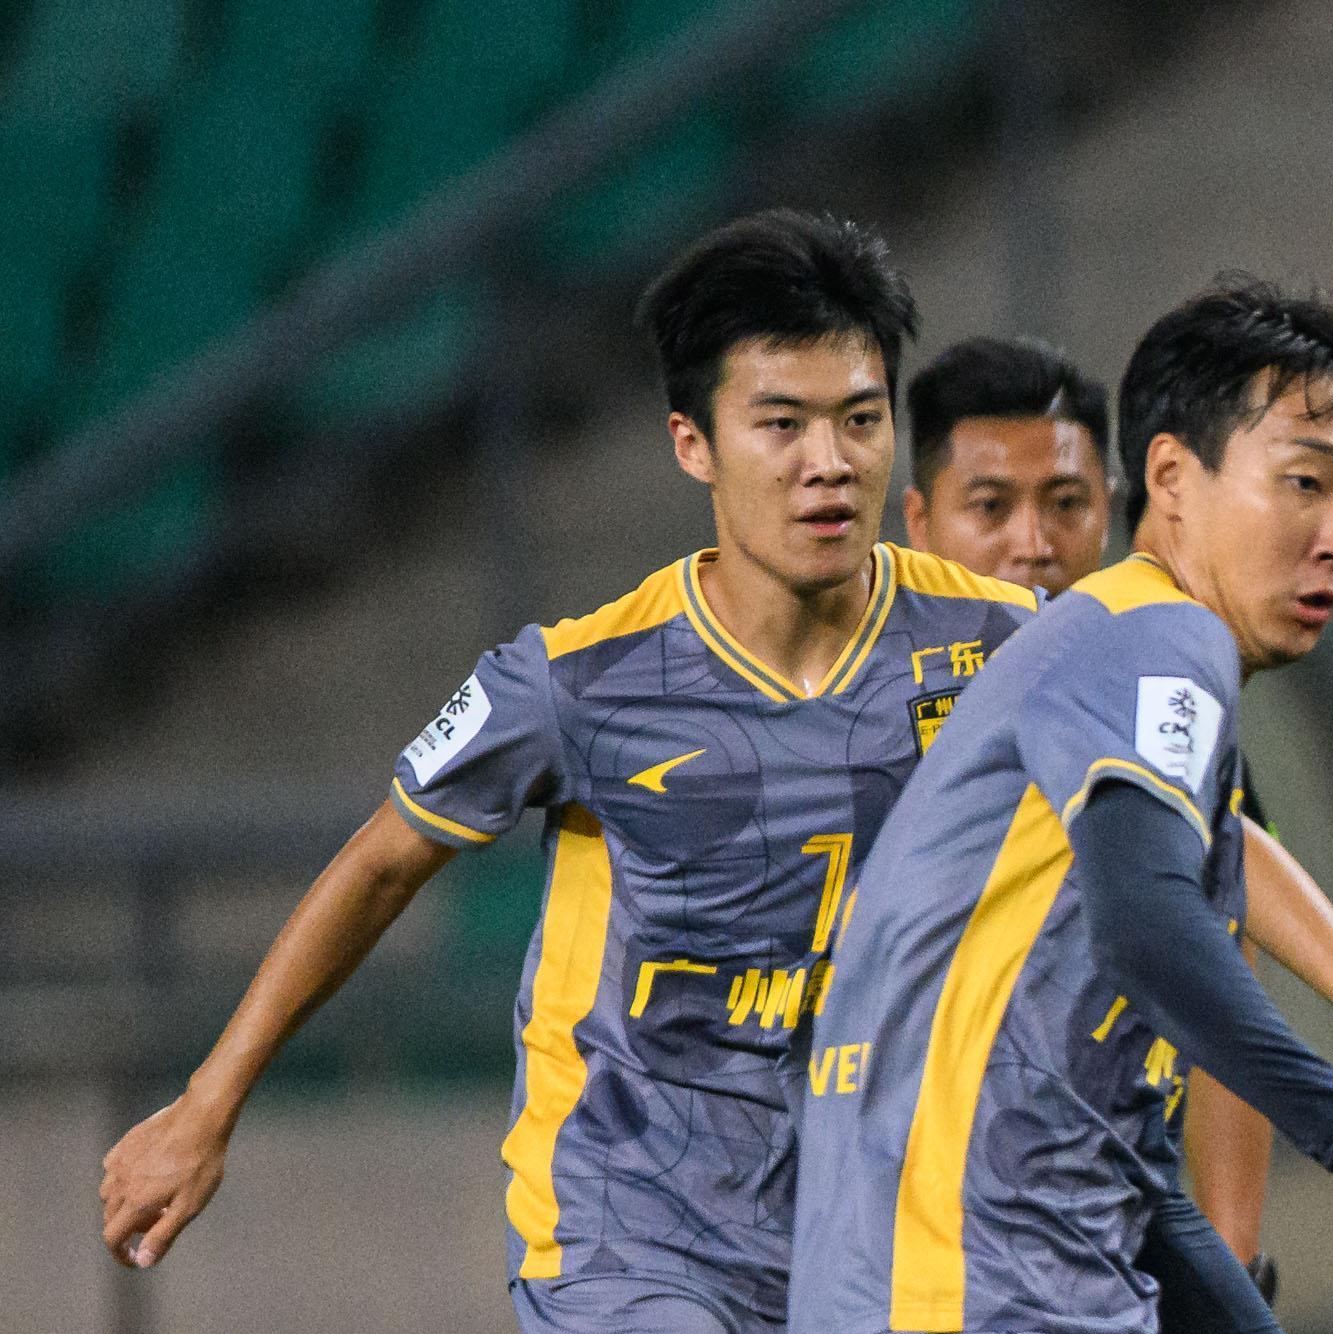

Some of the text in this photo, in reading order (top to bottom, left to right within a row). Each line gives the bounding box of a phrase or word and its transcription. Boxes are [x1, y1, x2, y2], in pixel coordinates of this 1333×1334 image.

[911, 640, 984, 684] 广东
[916, 695, 960, 719] 广州
[629, 959, 836, 1029] 广州
